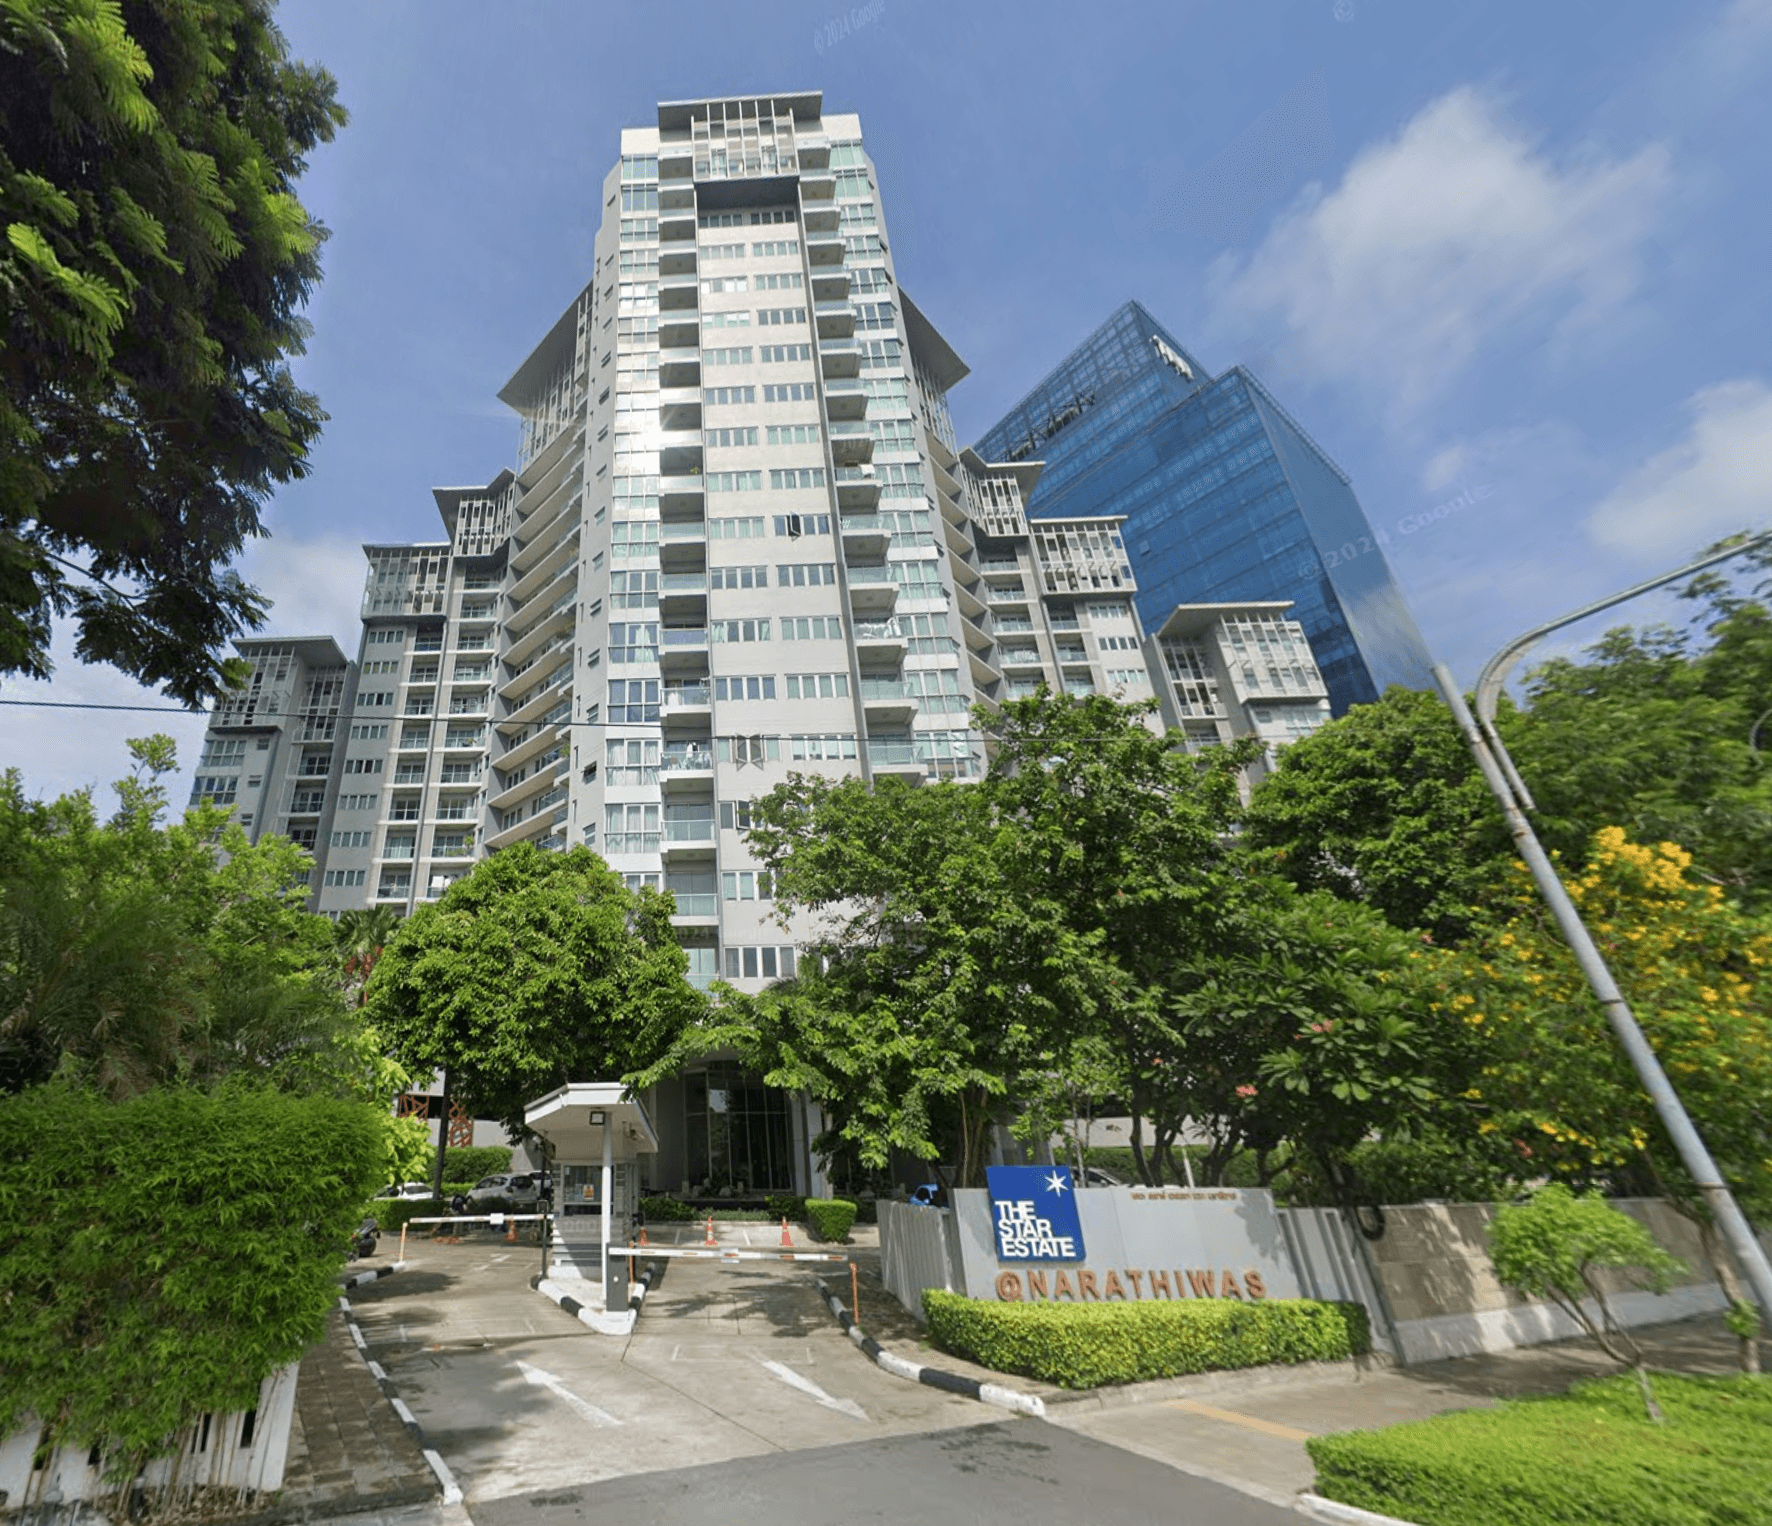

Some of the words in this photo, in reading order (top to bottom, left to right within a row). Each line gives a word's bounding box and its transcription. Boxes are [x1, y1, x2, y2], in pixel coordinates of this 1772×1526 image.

[995, 1201, 1036, 1220] THE
[998, 1218, 1053, 1239] STAR
[1002, 1236, 1076, 1258] ESTATE
[995, 1269, 1267, 1302] @NARATHIWAS
